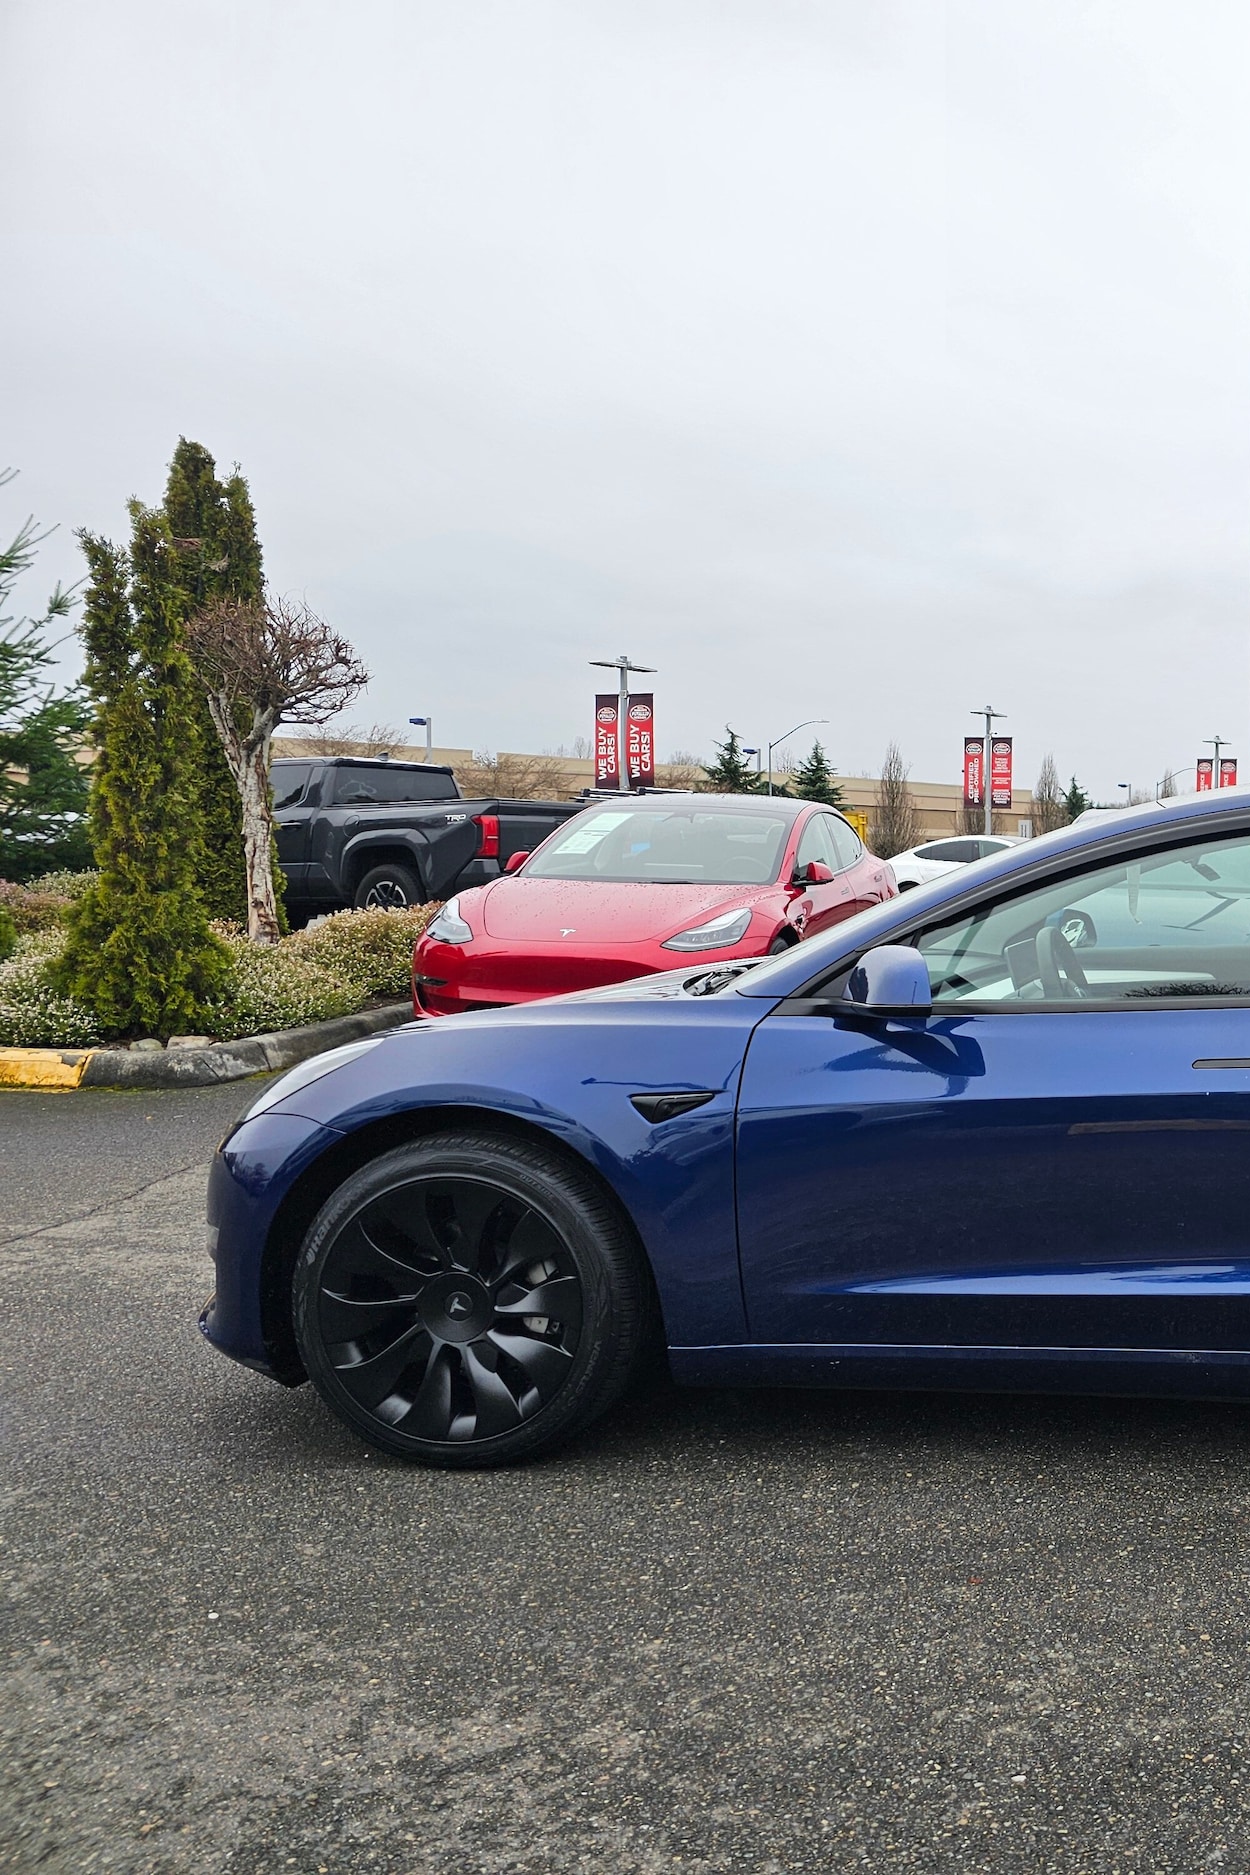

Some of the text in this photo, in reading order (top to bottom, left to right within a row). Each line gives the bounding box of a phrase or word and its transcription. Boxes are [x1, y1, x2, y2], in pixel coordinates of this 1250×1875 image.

[598, 726, 607, 780] WE BUY
[607, 733, 616, 774] CARS!
[630, 724, 640, 753] BUY
[641, 731, 651, 772] CARS!
[630, 756, 640, 778] WE
